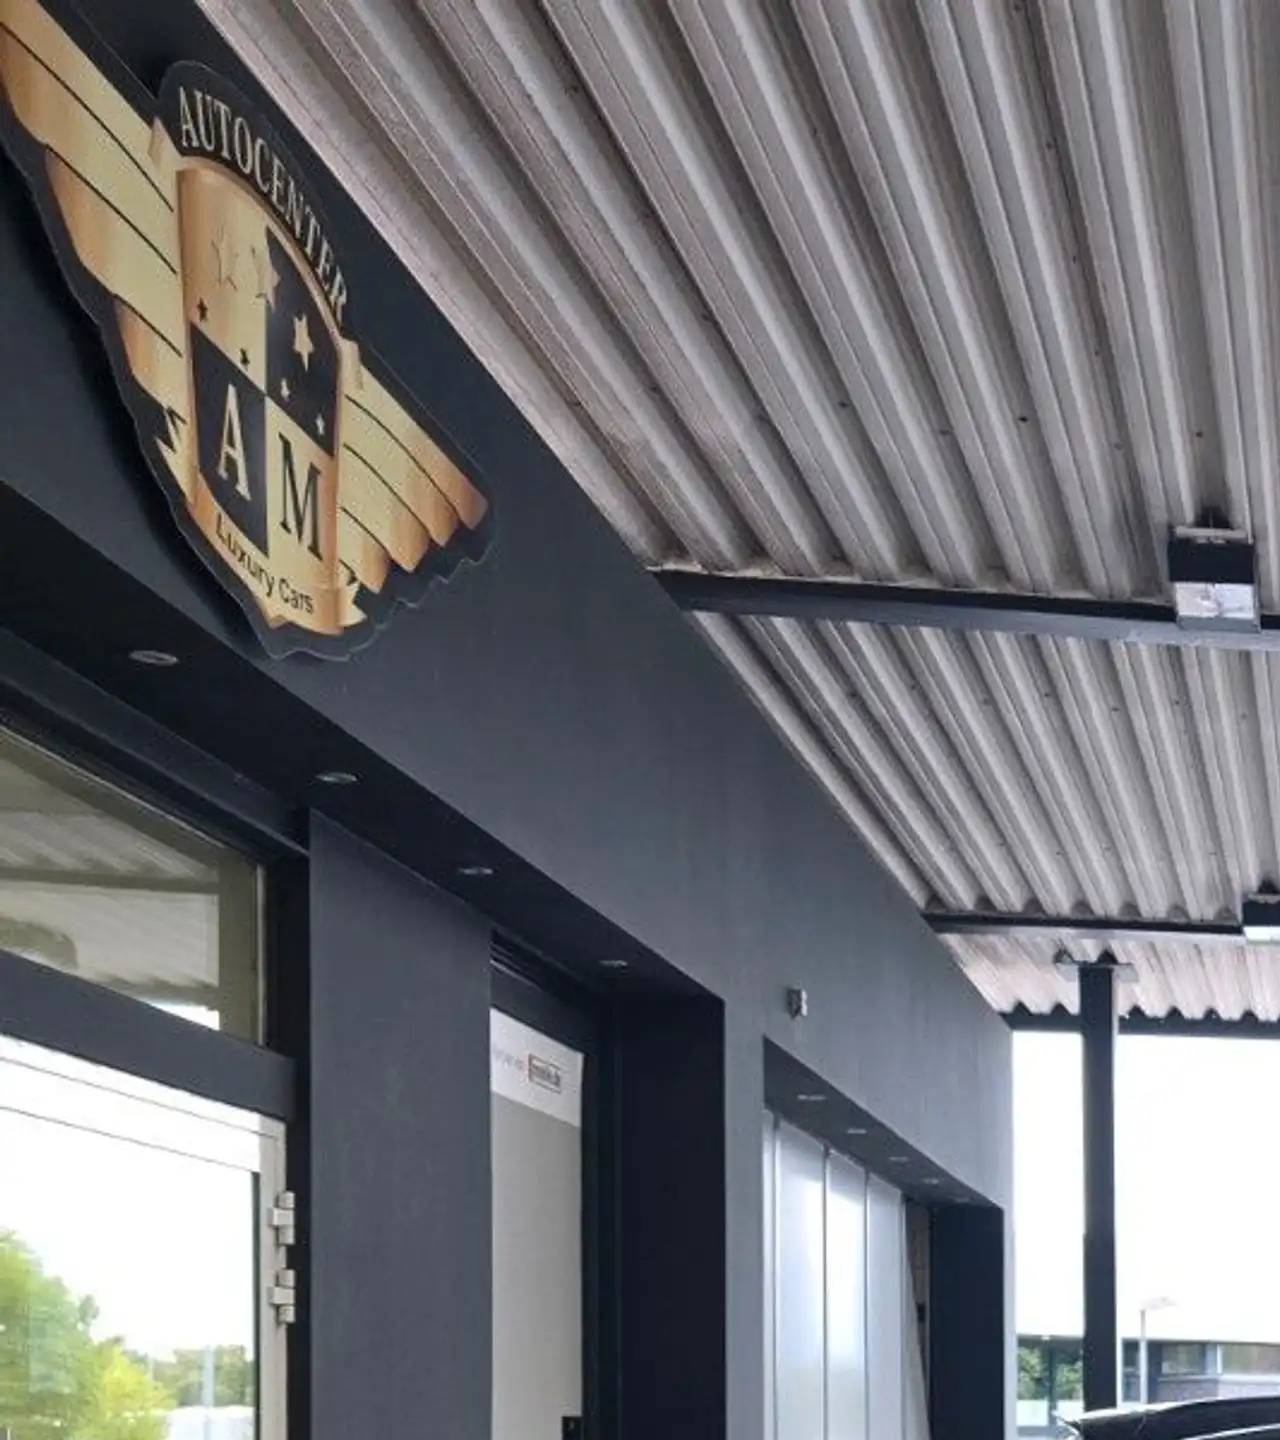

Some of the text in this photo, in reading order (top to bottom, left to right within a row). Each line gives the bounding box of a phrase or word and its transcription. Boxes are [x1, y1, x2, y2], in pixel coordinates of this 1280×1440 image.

[178, 86, 348, 327] AUTOCENTER
[218, 382, 323, 561] A M
[215, 512, 315, 615] Luxury Cars
